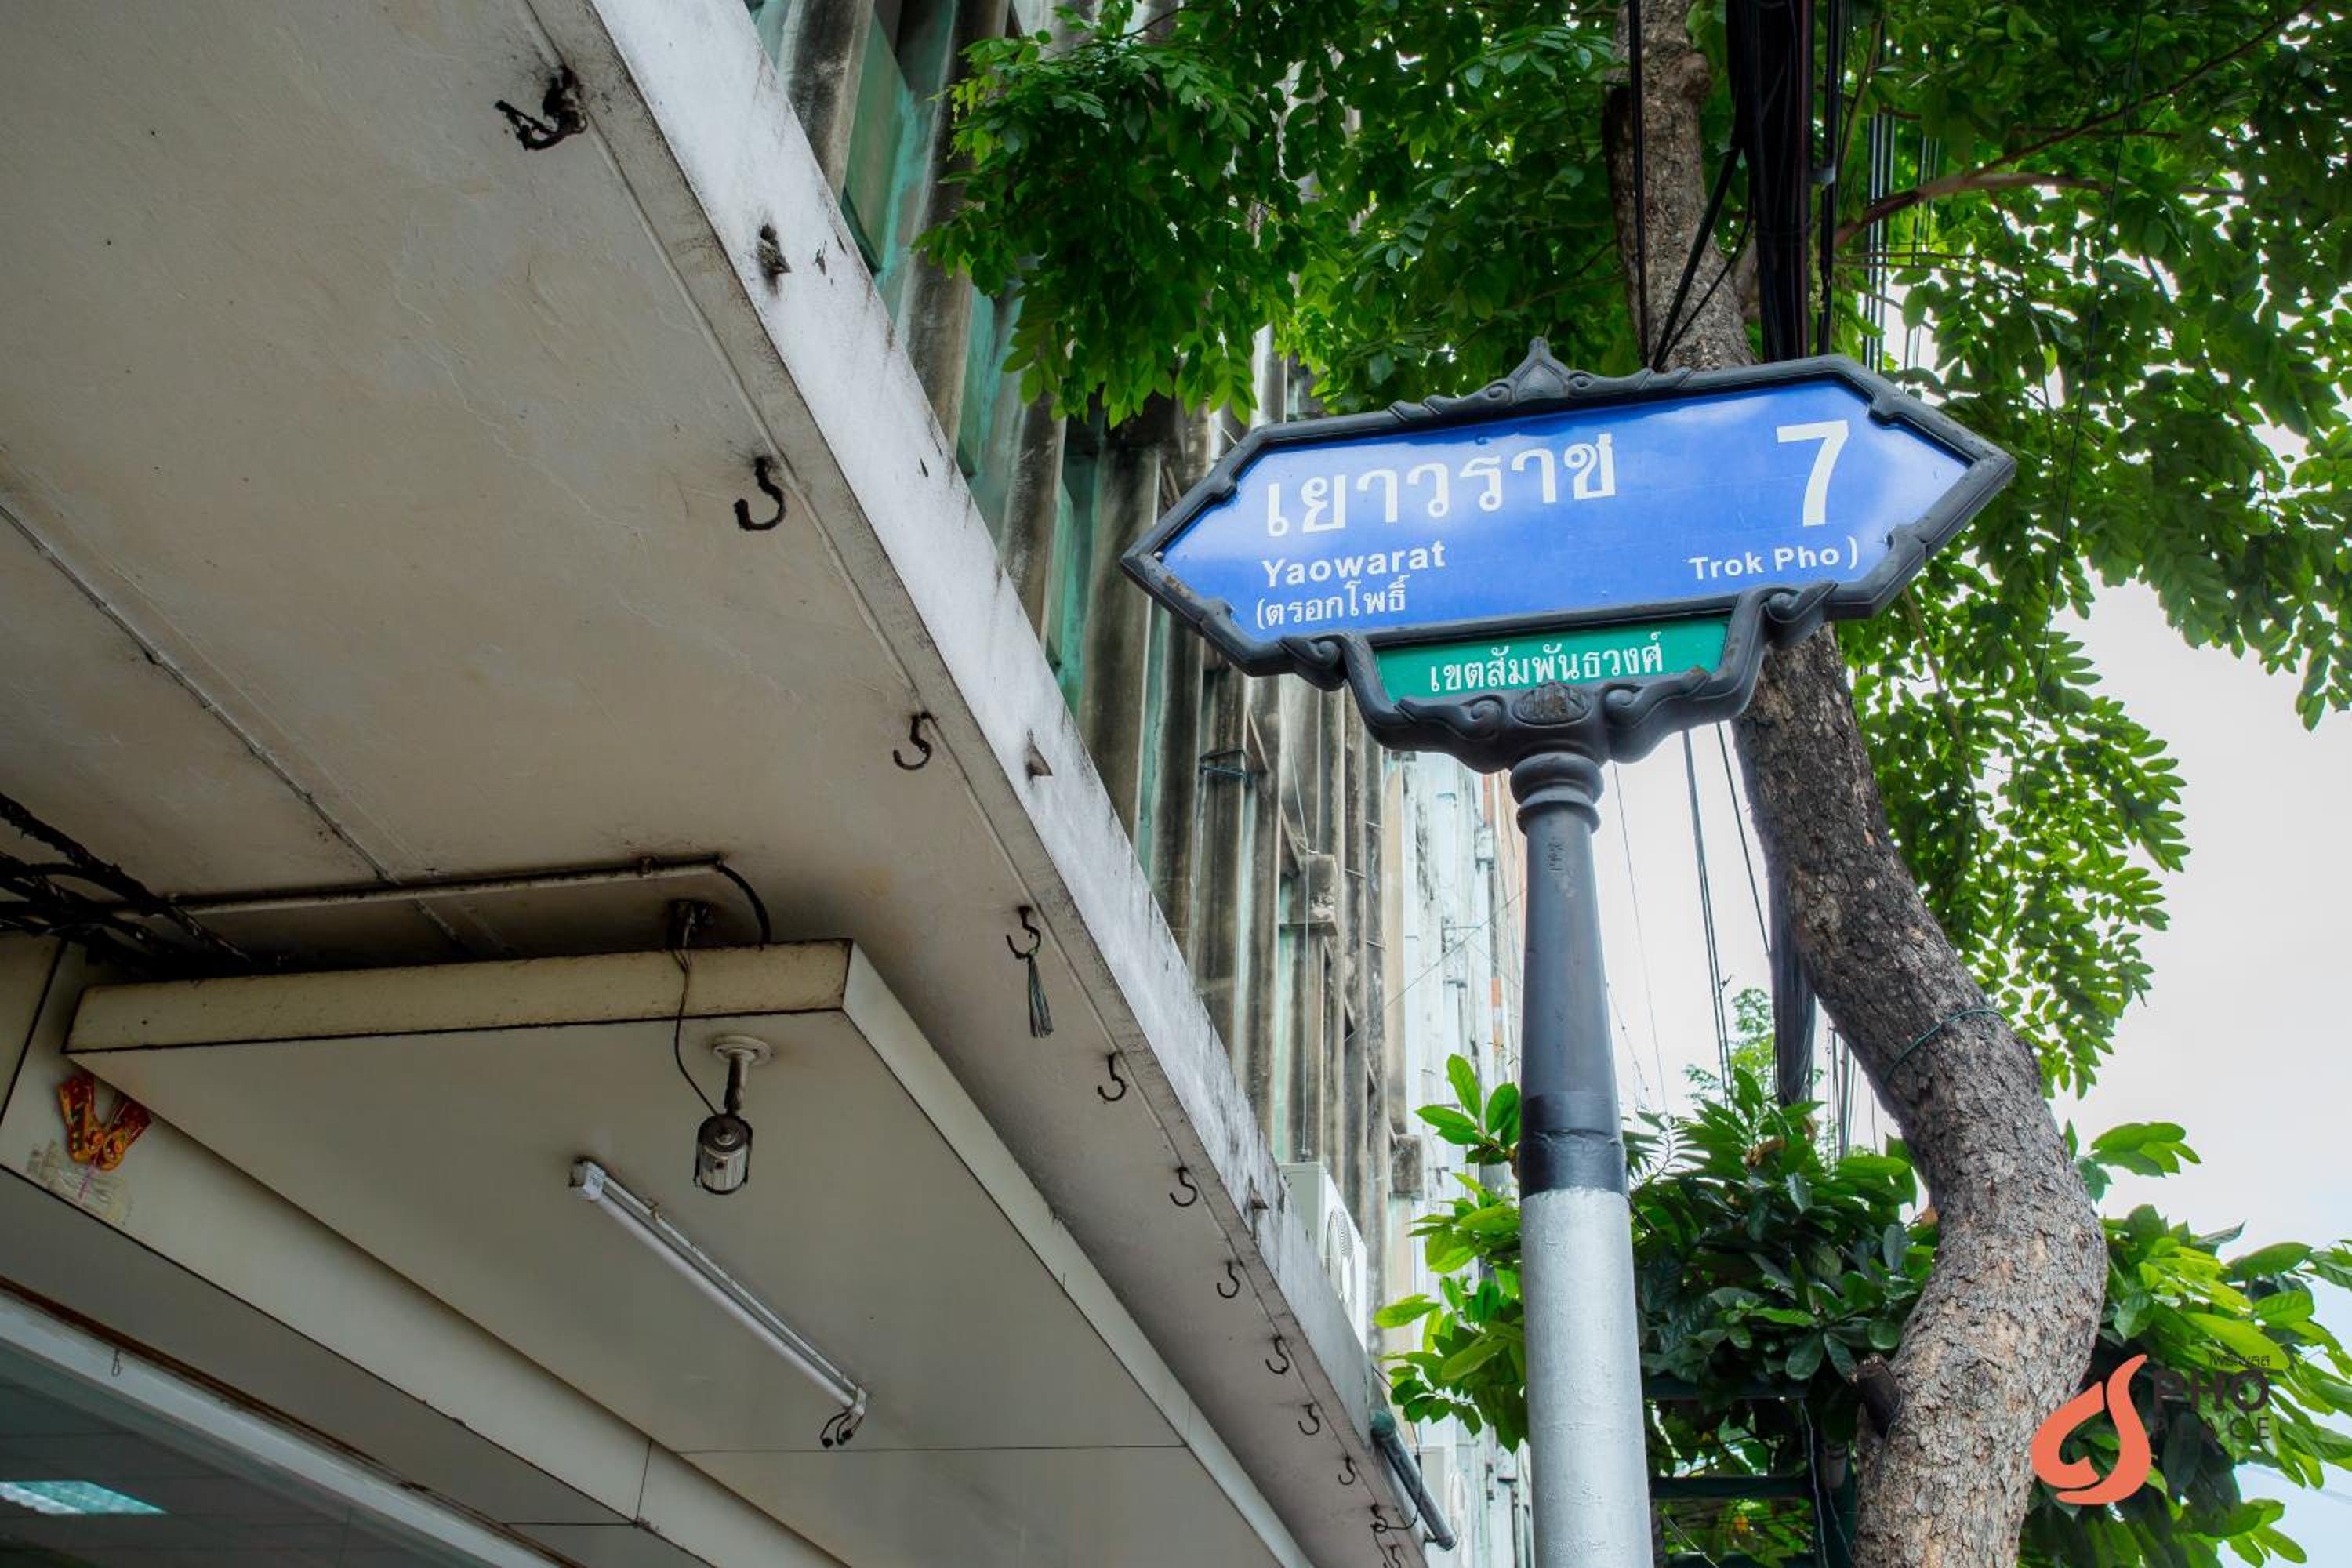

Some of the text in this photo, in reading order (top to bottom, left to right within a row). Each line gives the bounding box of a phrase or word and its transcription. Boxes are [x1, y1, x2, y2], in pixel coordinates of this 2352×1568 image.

[1266, 419, 1849, 537] เยาวราช 7
[1261, 539, 1446, 588] Yaowarat
[1687, 551, 1764, 580] Trok
[1256, 575, 1410, 630] (ตรอกโพธิ์
[1430, 631, 1664, 692] เขตสัมพันธวงศ์
